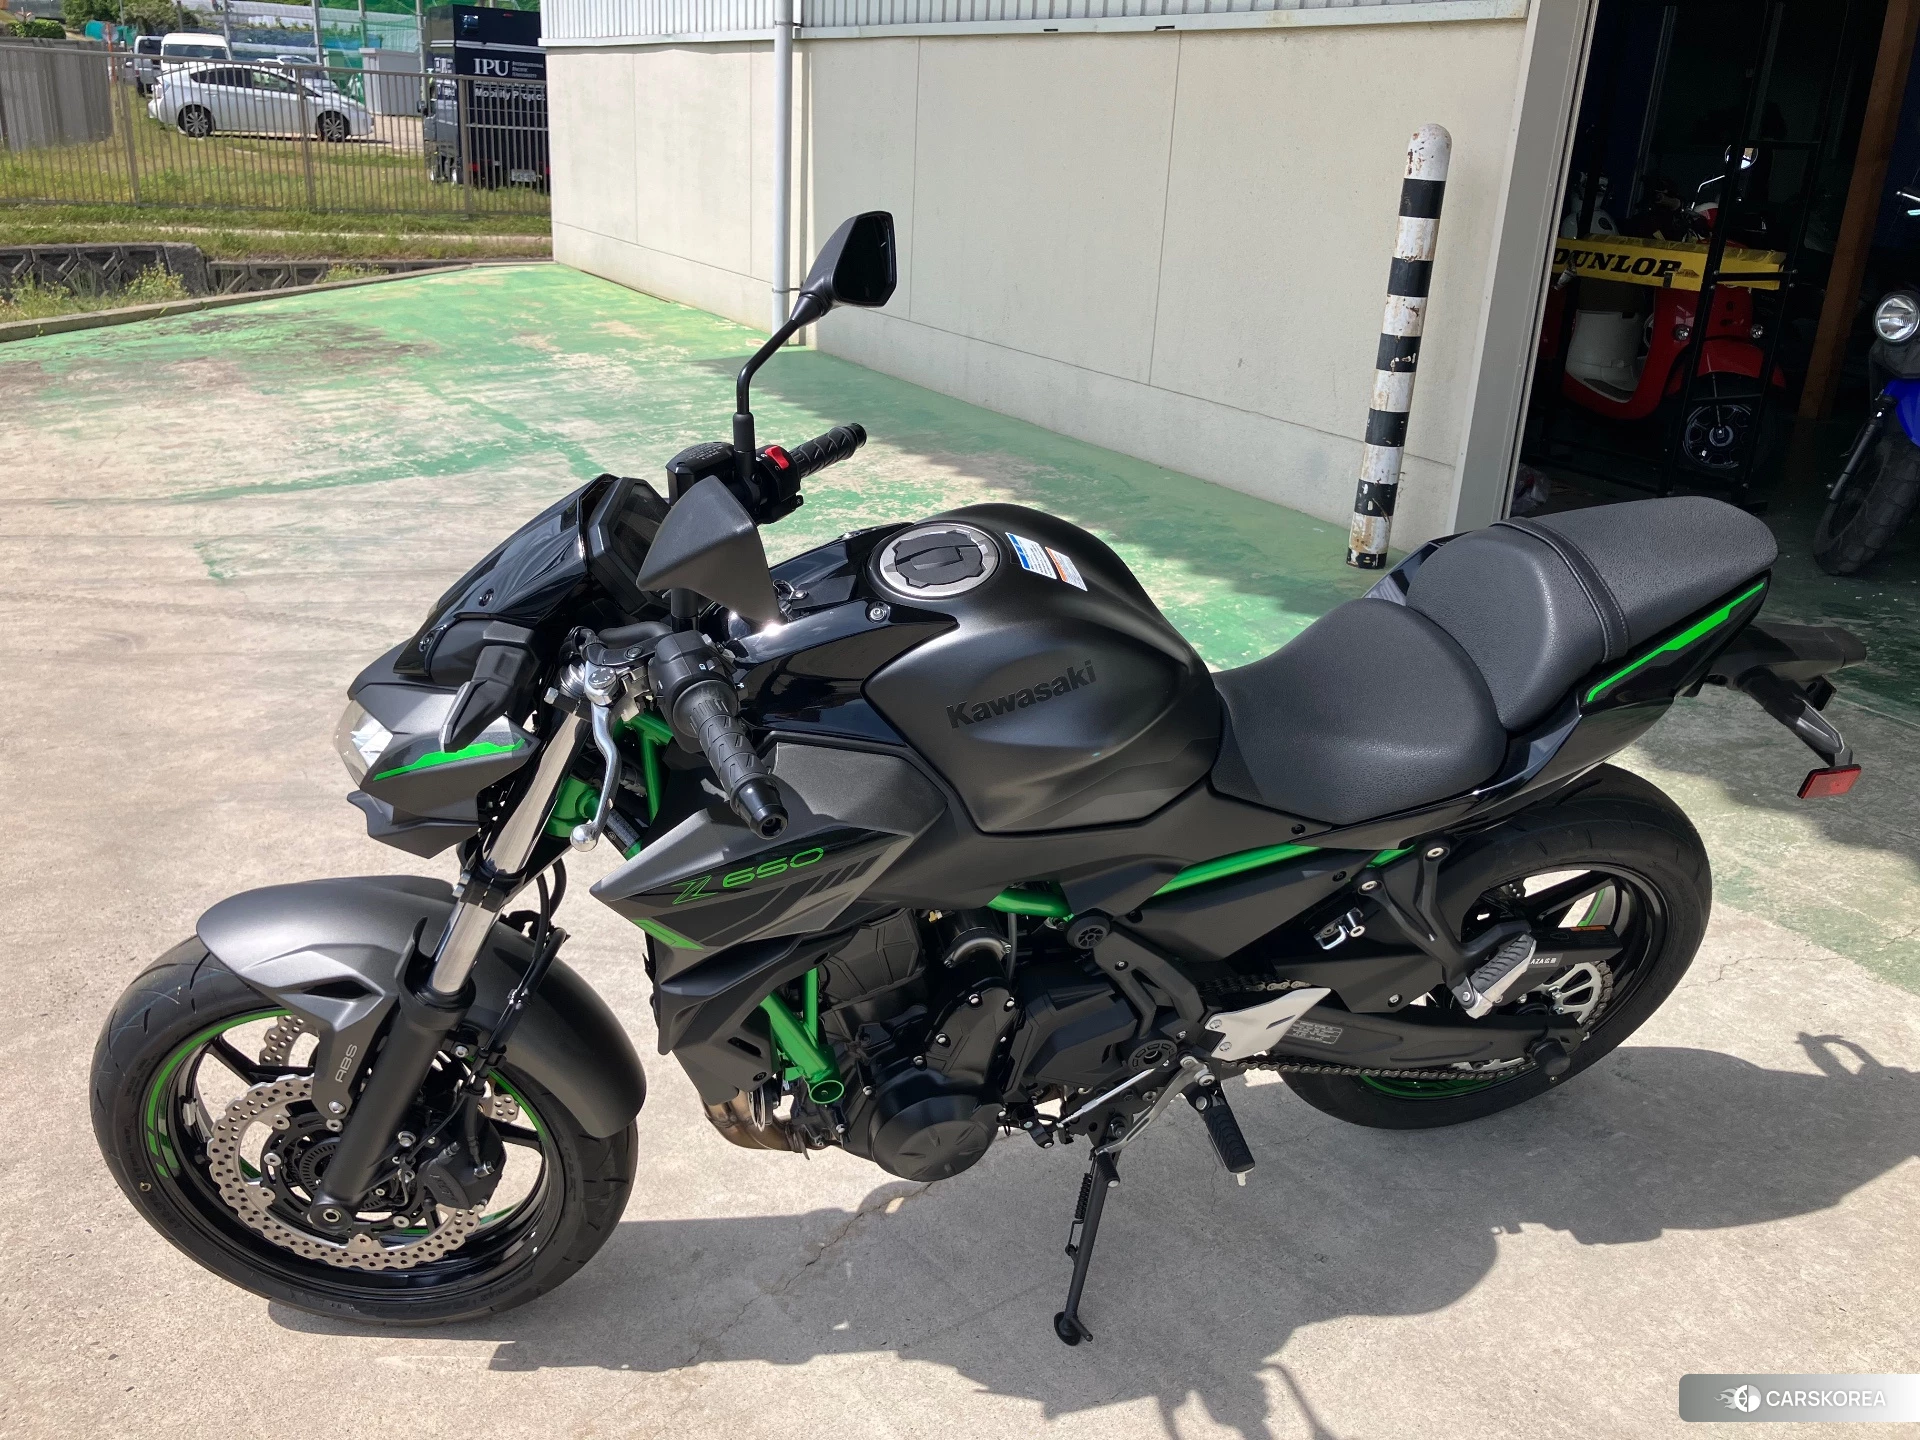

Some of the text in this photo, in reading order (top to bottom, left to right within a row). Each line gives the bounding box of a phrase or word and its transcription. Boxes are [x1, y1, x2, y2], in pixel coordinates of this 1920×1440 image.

[473, 58, 510, 77] IPU
[1554, 247, 1682, 278] DUNLOP
[946, 659, 1097, 729] Kawasaki
[335, 1043, 358, 1083] ABS
